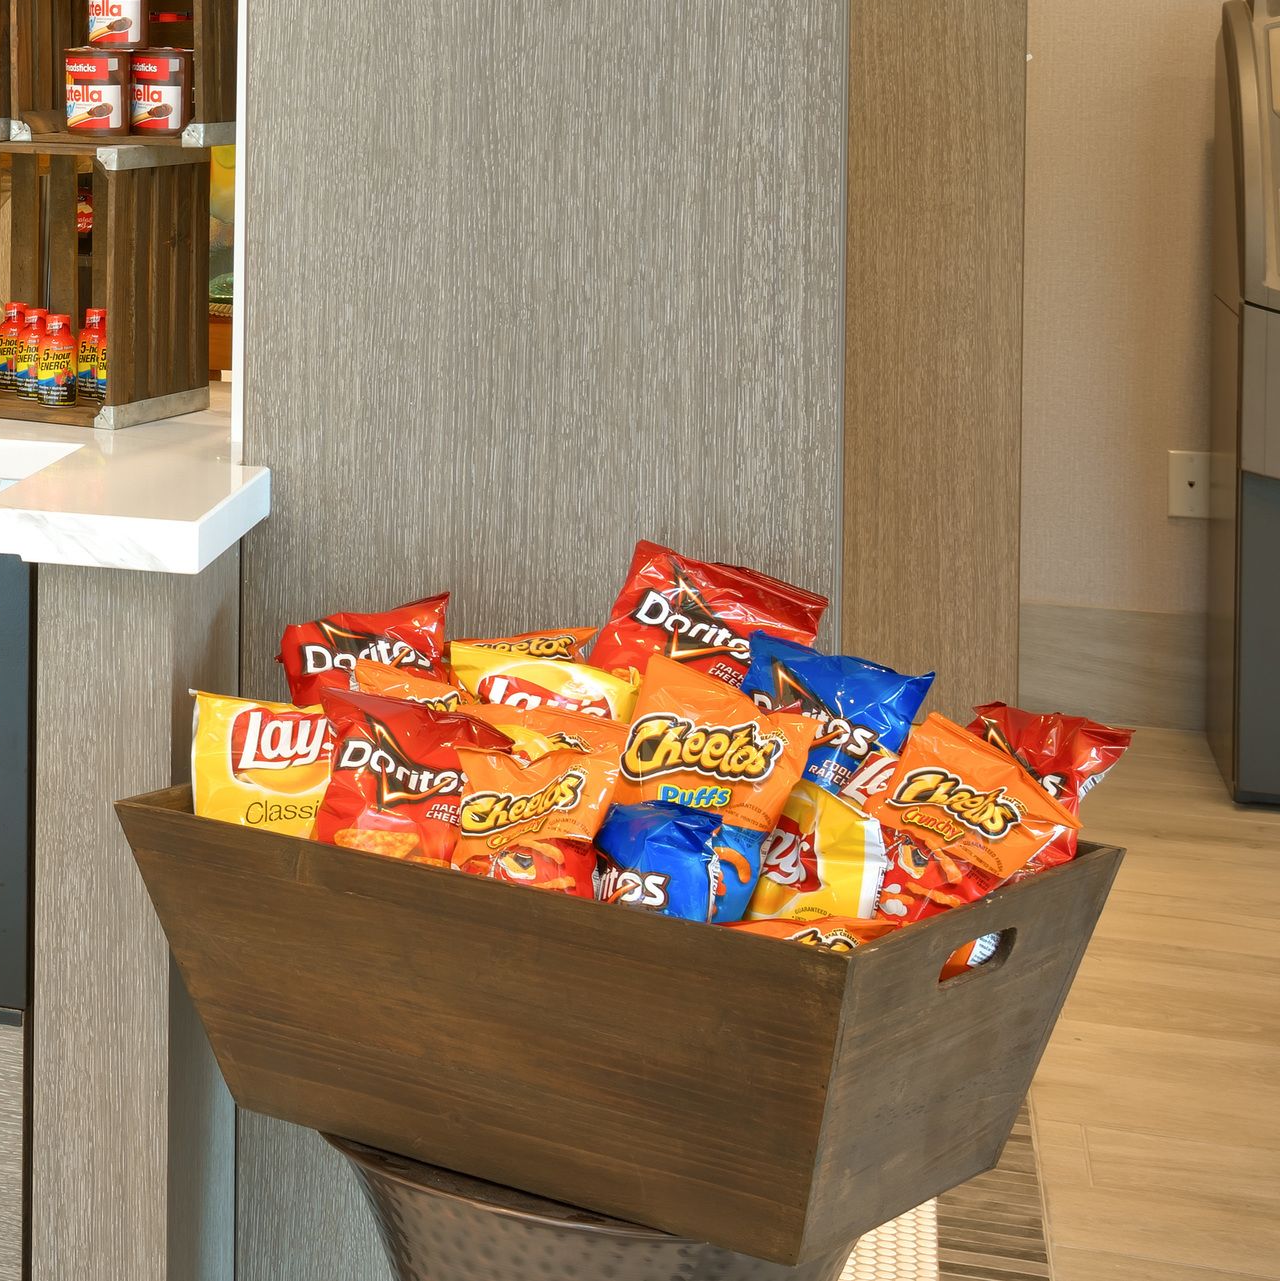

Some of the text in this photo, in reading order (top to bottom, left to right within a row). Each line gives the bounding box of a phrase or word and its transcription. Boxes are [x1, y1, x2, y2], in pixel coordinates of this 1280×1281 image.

[41, 360, 71, 371] ENERGY
[43, 348, 71, 361] 5-hour
[624, 716, 778, 778] Cheetos
[461, 771, 584, 834] Cheetos
[659, 785, 732, 807] Puffs
[899, 771, 1015, 837] Cheetos
[245, 801, 319, 825] Classi
[901, 807, 964, 841] Crunchy
